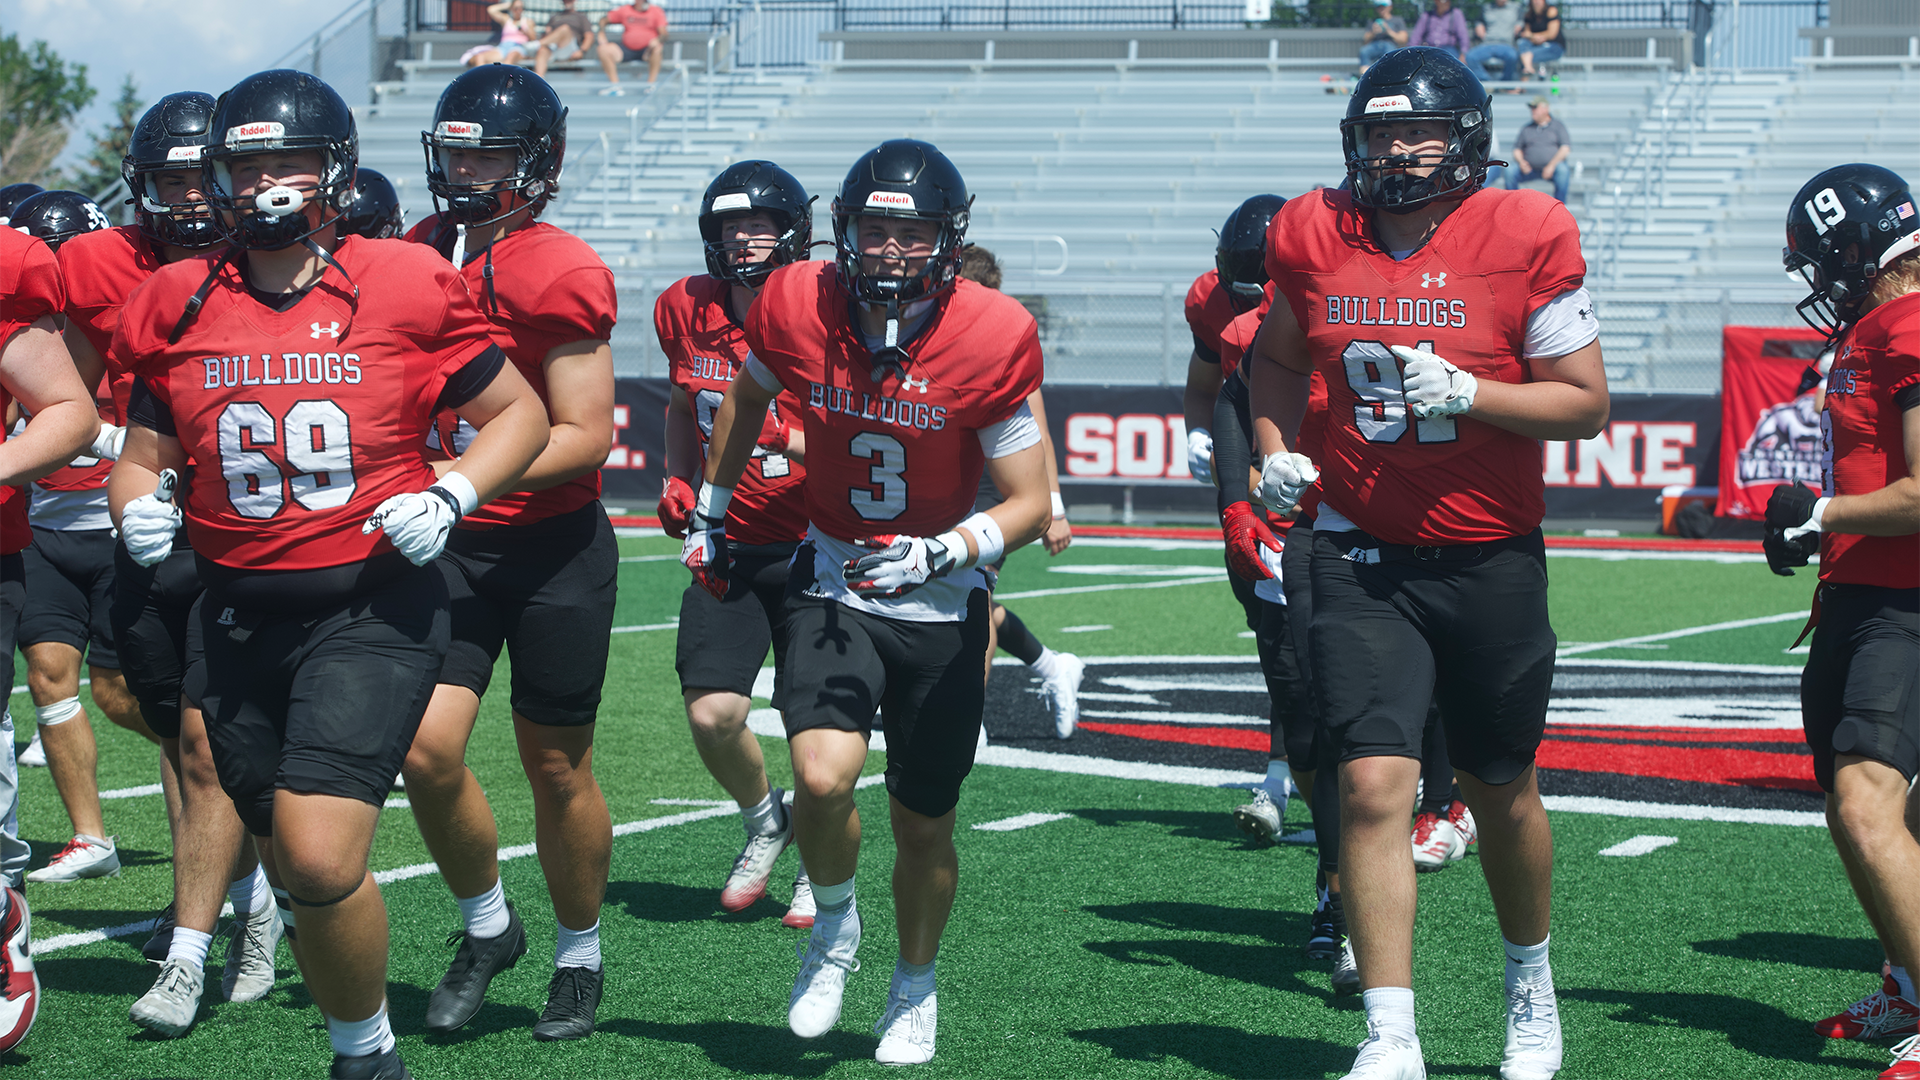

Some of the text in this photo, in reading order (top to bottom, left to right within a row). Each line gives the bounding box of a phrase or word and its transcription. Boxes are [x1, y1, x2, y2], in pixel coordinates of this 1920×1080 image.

[240, 124, 271, 136] Riddell
[83, 202, 110, 230] 35
[872, 194, 909, 204] Riddell
[1804, 187, 1847, 236] 19
[1326, 295, 1467, 329] BULLDOGS
[203, 352, 362, 390] BULLDOGS
[691, 355, 741, 382] BULL
[808, 381, 948, 431] BULLDOGS
[217, 398, 358, 520] 69
[848, 430, 909, 522] 3
